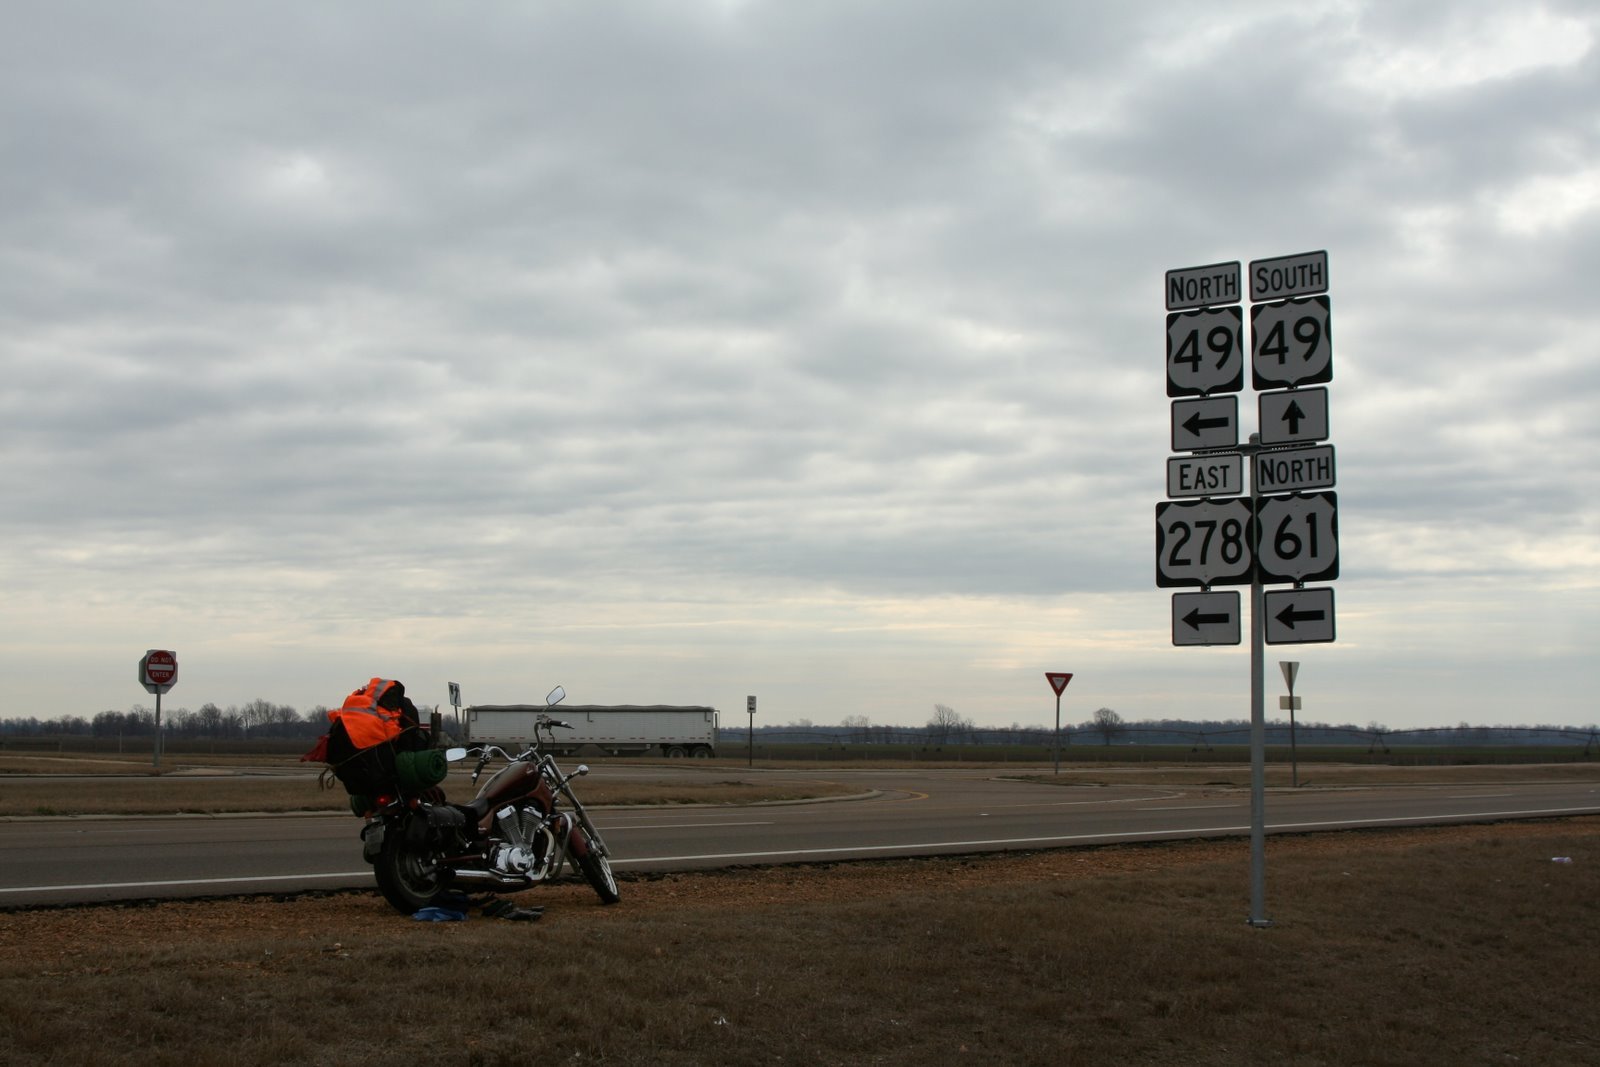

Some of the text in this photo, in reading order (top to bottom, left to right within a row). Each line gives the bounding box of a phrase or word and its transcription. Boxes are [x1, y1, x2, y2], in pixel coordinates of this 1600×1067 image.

[1171, 273, 1236, 303] NORTH
[1256, 263, 1322, 293] SOUTH
[1174, 326, 1233, 373] 49
[1259, 316, 1321, 365] 49
[1179, 464, 1230, 490] EAST
[1260, 456, 1330, 486] NORTH
[1168, 518, 1243, 566] 278
[1274, 512, 1318, 560] 61
